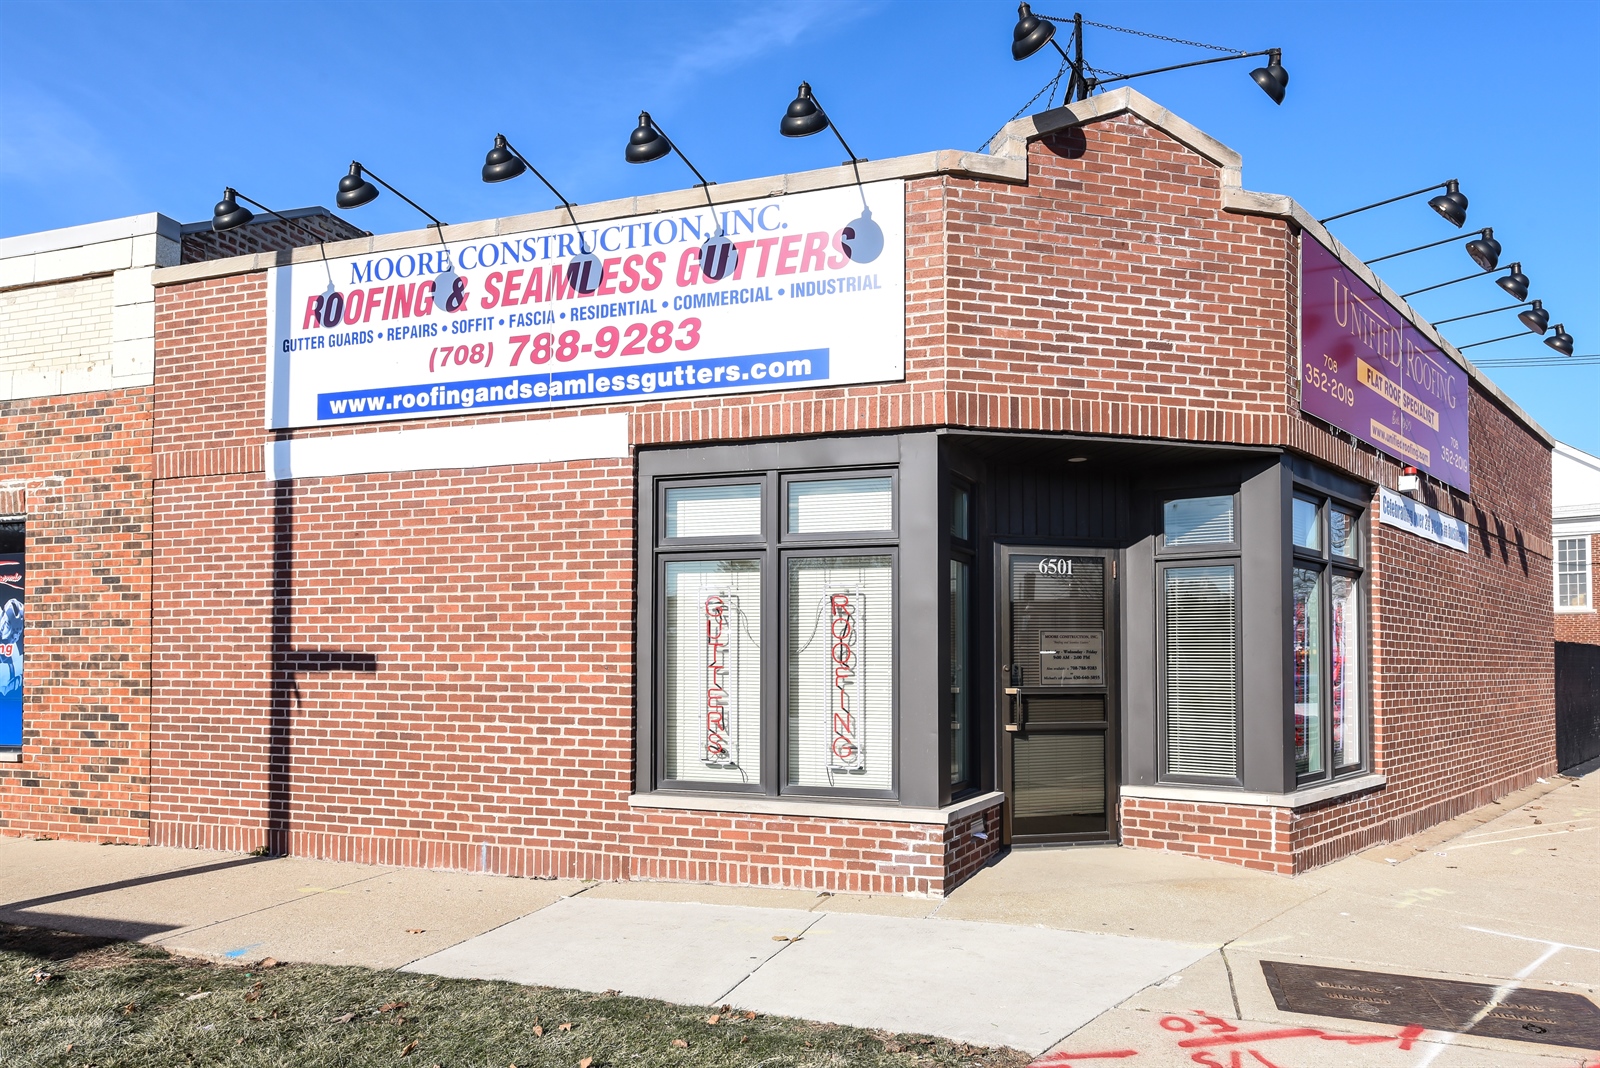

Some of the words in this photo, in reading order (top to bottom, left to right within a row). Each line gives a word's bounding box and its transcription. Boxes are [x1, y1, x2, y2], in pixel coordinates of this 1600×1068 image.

[349, 249, 452, 284] MOORE
[719, 204, 788, 236] INC.
[302, 279, 437, 330] ROOFING
[445, 276, 468, 313] &
[480, 251, 666, 310] SEAMLESS
[676, 226, 856, 288] GUTTERS
[282, 331, 325, 353] GUTTER
[328, 329, 374, 348] GUARDS
[387, 322, 438, 342] REPAIRS
[451, 316, 494, 335] SOFFIT
[508, 310, 556, 329] FASCIA
[570, 298, 657, 322] RESIDENTIAL
[673, 289, 773, 311] COMMERCIAL
[790, 274, 882, 299] INDUSTRIAL
[429, 341, 495, 372] (708)
[508, 317, 702, 367] 788-9283
[1323, 353, 1338, 374] 708
[1333, 277, 1401, 368] UNIFIED
[1406, 337, 1456, 409] ROOFING
[329, 356, 811, 415] www.roofingandseamlessgutters.com
[1305, 363, 1355, 407] 352-2019
[1367, 367, 1383, 393] FLAT
[1384, 378, 1401, 404] ROOF
[1402, 391, 1435, 428] SPECIALIST
[1441, 445, 1468, 473] 352-2019
[1450, 436, 1459, 450] 708
[1038, 558, 1073, 575] 6501
